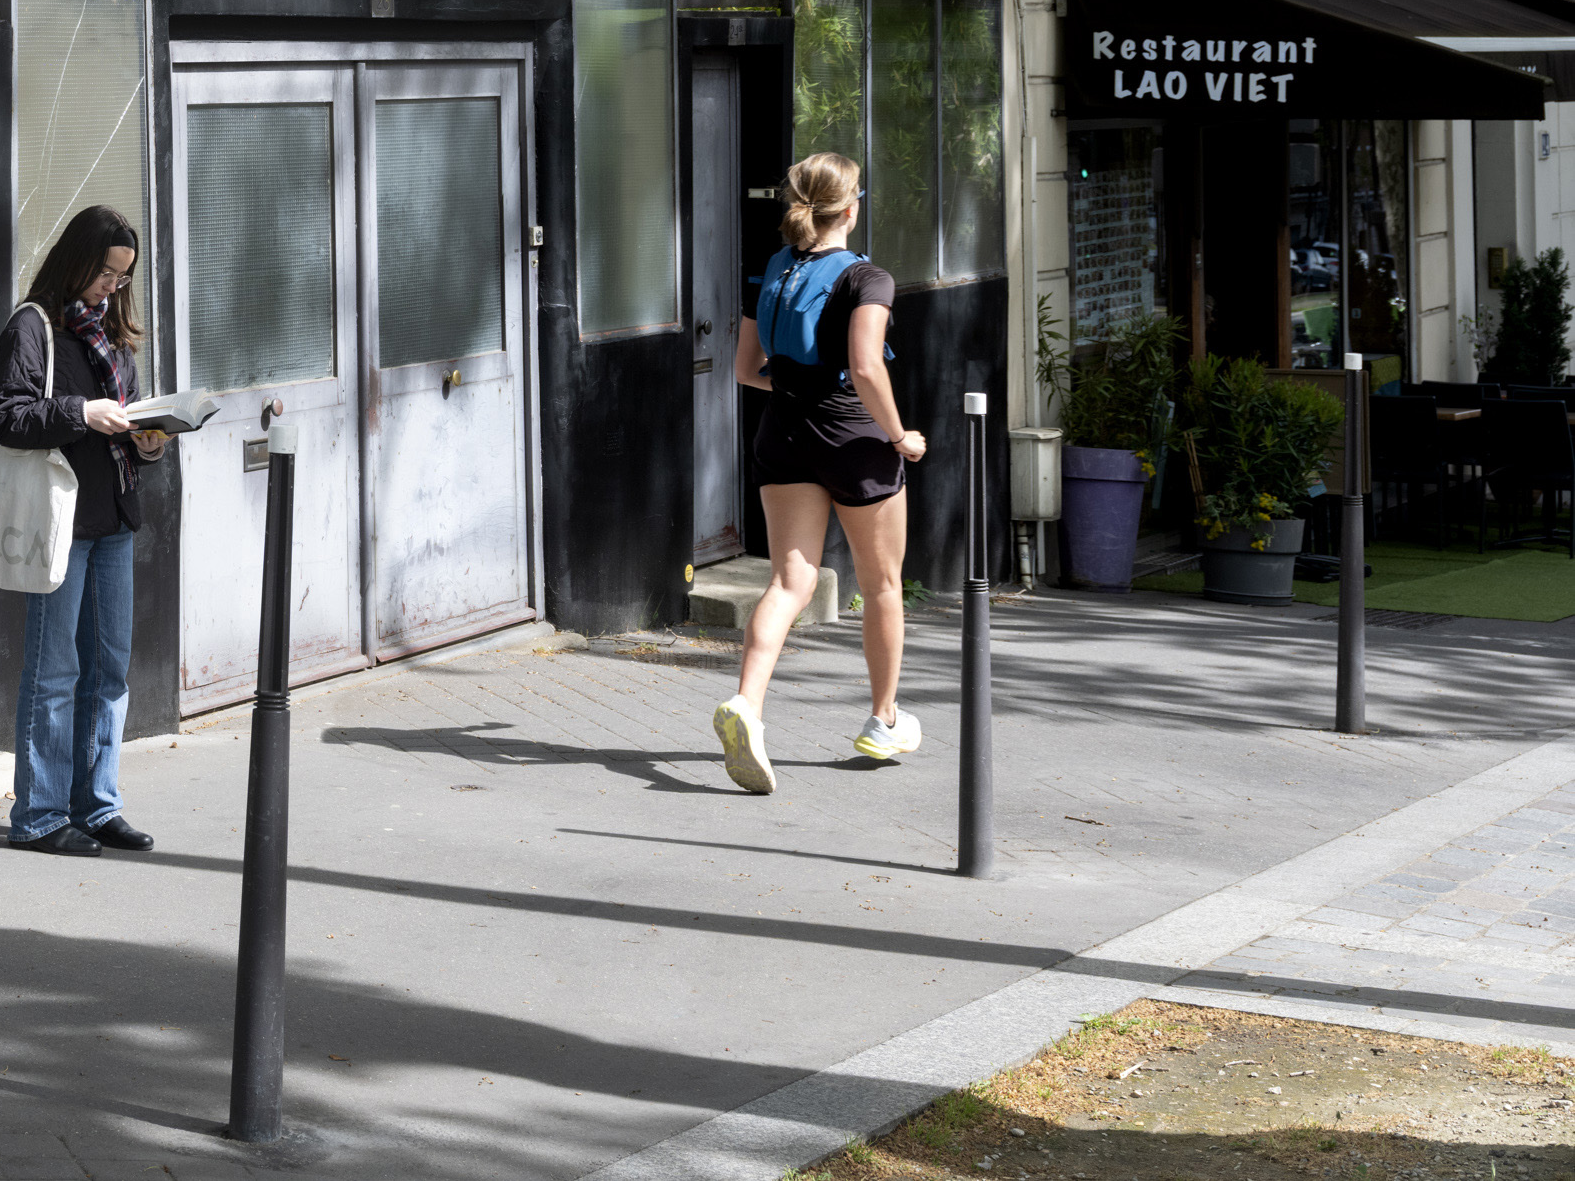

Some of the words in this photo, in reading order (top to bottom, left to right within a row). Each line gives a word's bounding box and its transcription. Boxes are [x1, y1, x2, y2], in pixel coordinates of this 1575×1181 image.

[1092, 31, 1317, 64] Restaurant
[1114, 69, 1187, 100] LAO
[1204, 72, 1294, 103] VIET
